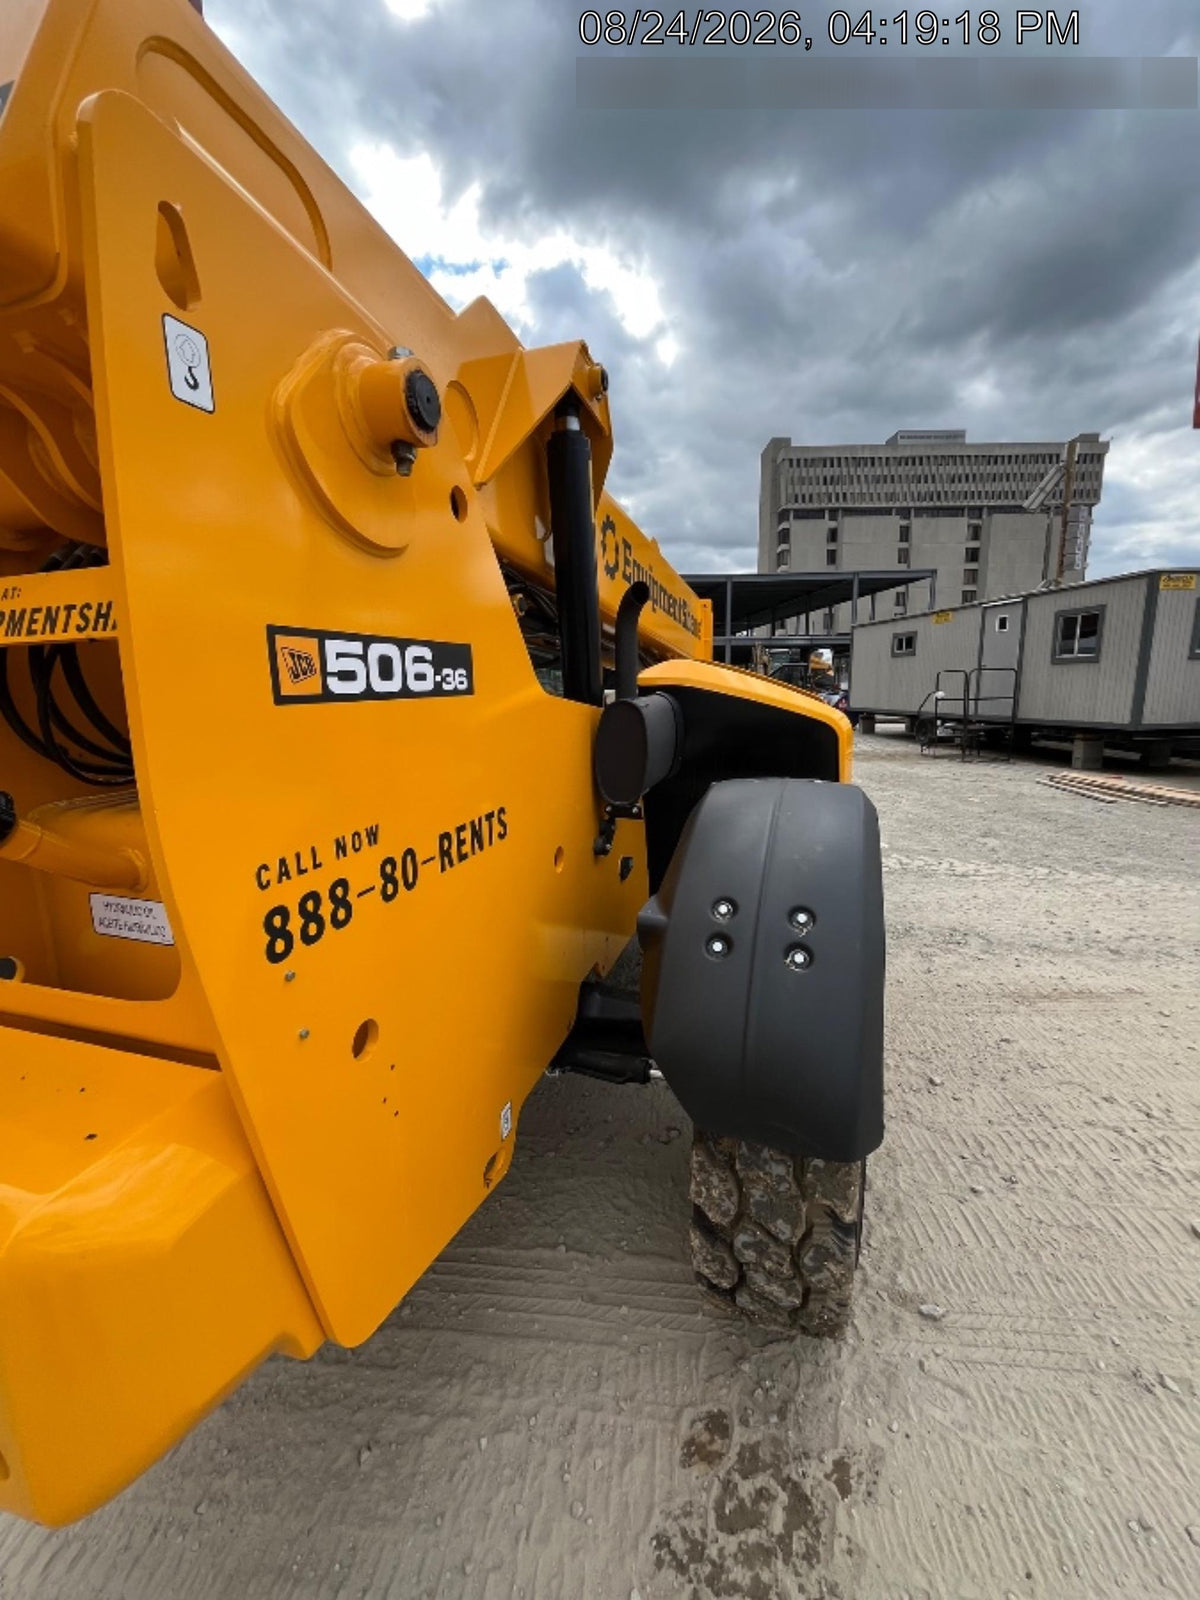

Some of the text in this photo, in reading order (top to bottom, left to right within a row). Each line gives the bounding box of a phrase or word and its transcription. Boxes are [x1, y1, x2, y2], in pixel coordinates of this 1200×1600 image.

[0, 601, 117, 637] MENTSH
[286, 639, 468, 694] JCB 506-36
[255, 824, 380, 891] CALL NOW
[262, 806, 508, 965] 888-80-RENTS
